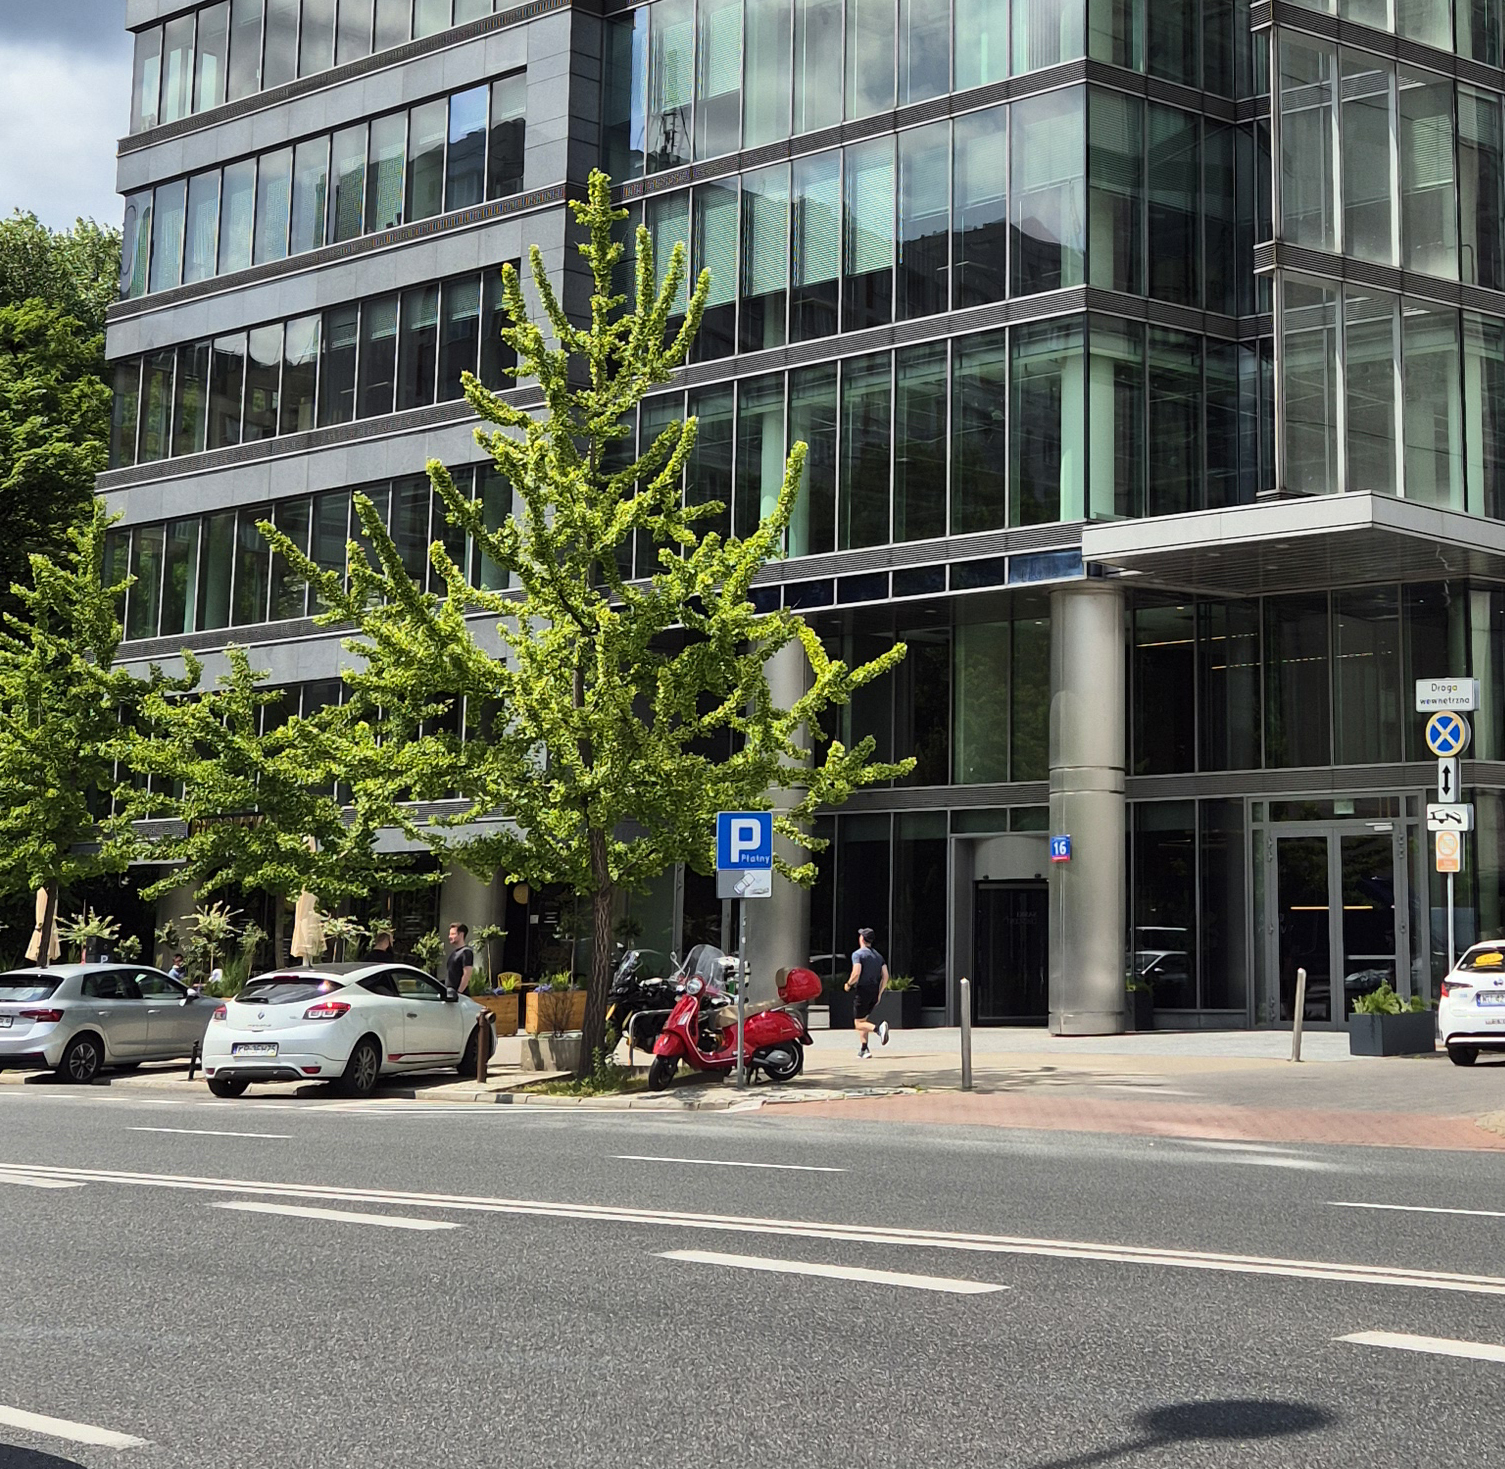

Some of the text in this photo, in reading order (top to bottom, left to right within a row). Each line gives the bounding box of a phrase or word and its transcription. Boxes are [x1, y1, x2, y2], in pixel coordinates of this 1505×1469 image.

[1431, 683, 1458, 694] Droga
[730, 818, 762, 863] P
[1054, 841, 1067, 855] 16
